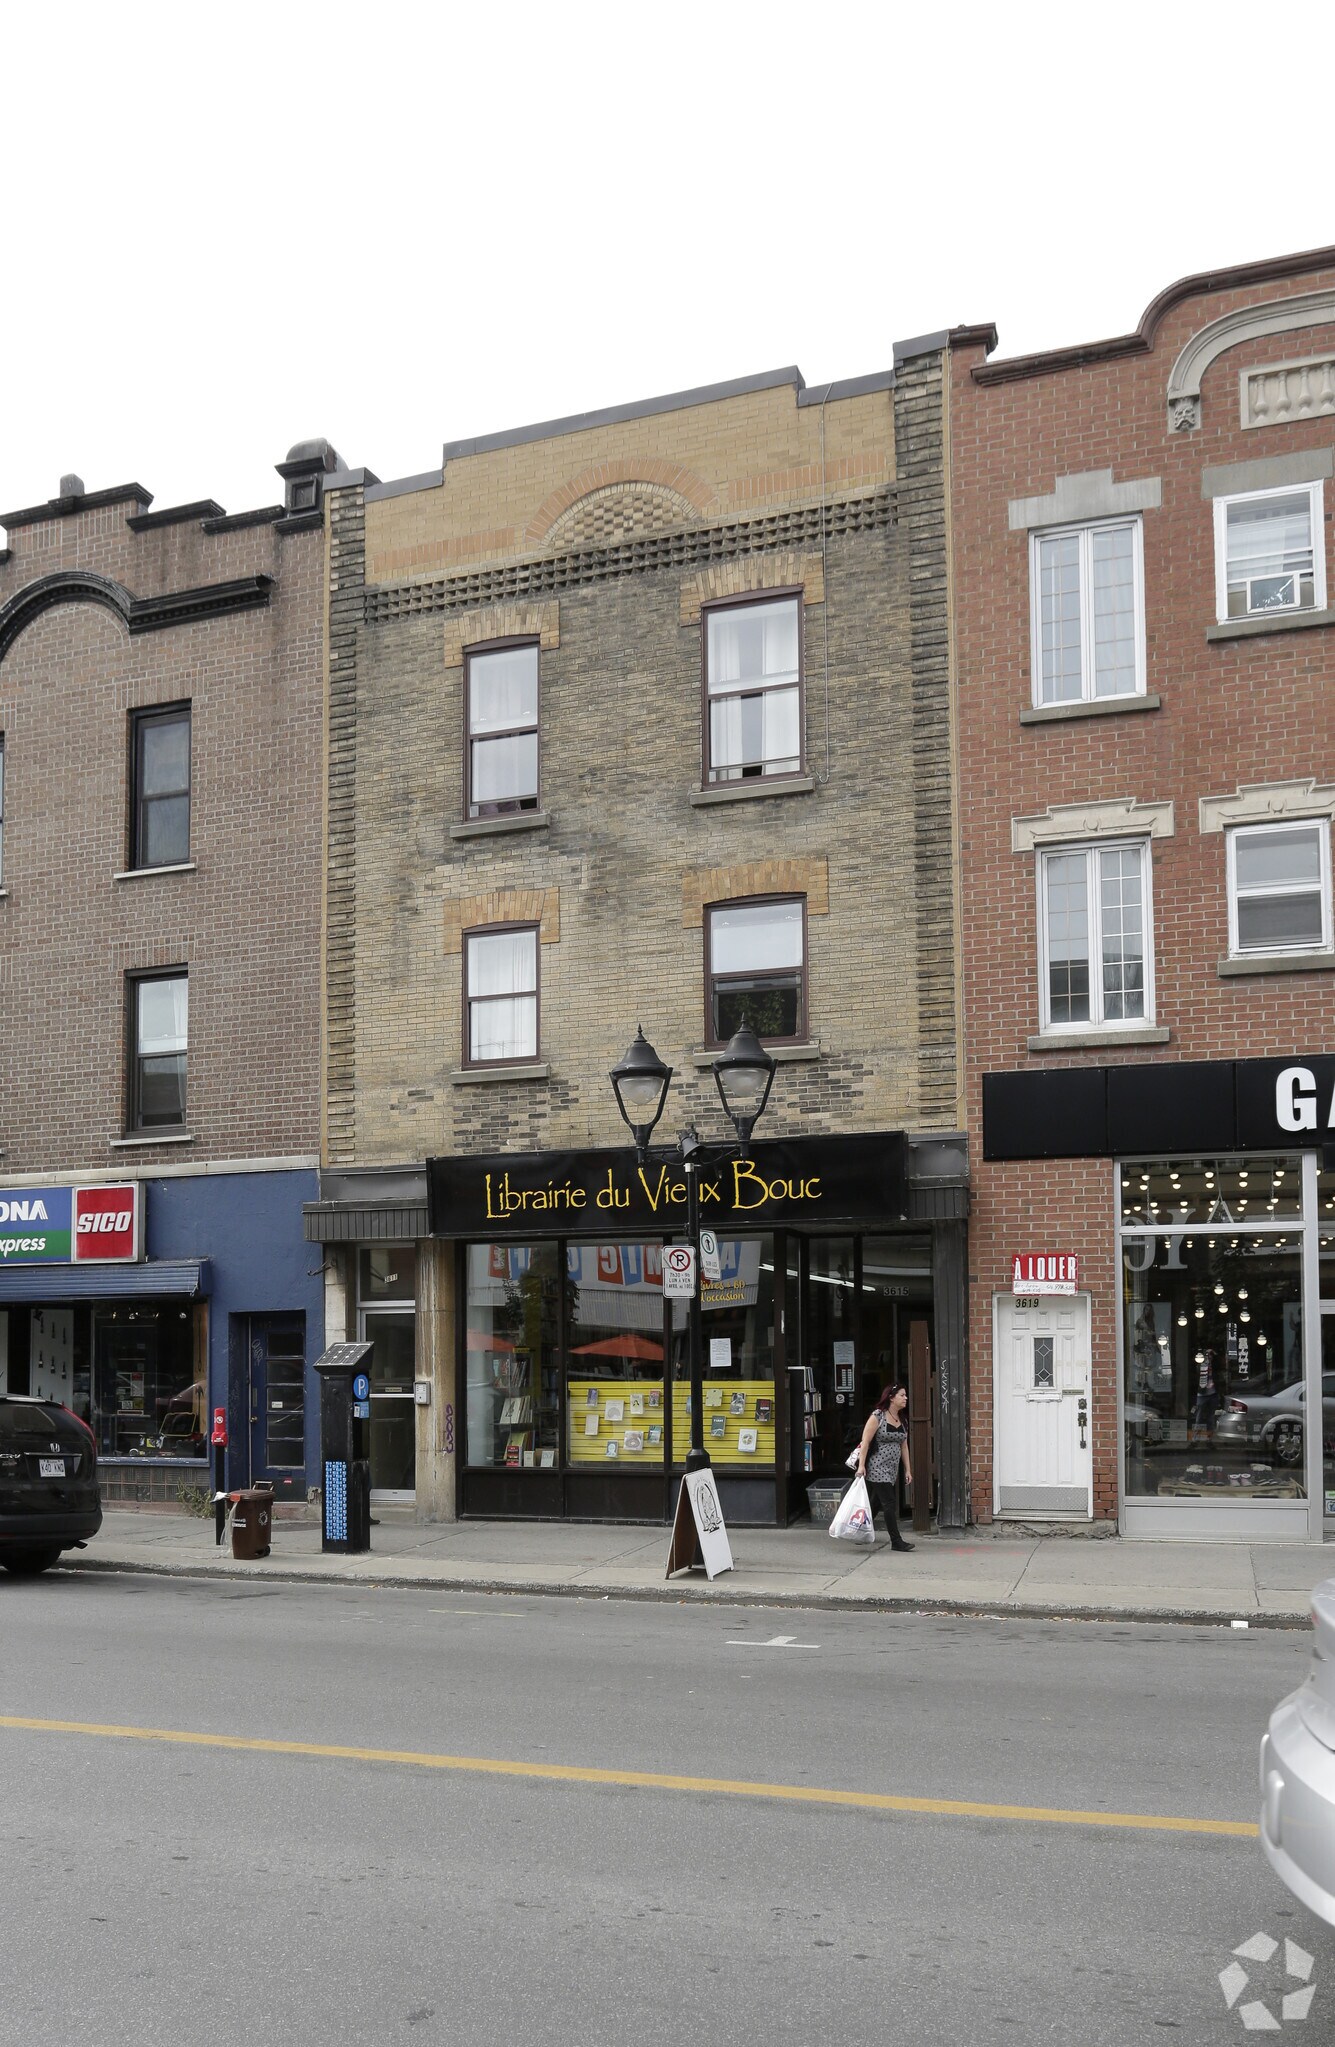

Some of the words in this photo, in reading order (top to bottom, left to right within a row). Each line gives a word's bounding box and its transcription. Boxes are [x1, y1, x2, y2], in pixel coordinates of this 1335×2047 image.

[1276, 1067, 1335, 1131] G
[485, 1172, 587, 1219] Librairie
[596, 1168, 630, 1208] du
[731, 1160, 823, 1209] Bouc
[77, 1211, 132, 1233] SICO
[1014, 1257, 1022, 1280] À
[1028, 1256, 1076, 1280] LOUER
[884, 1286, 909, 1296] 3615
[1015, 1298, 1040, 1308] 3619
